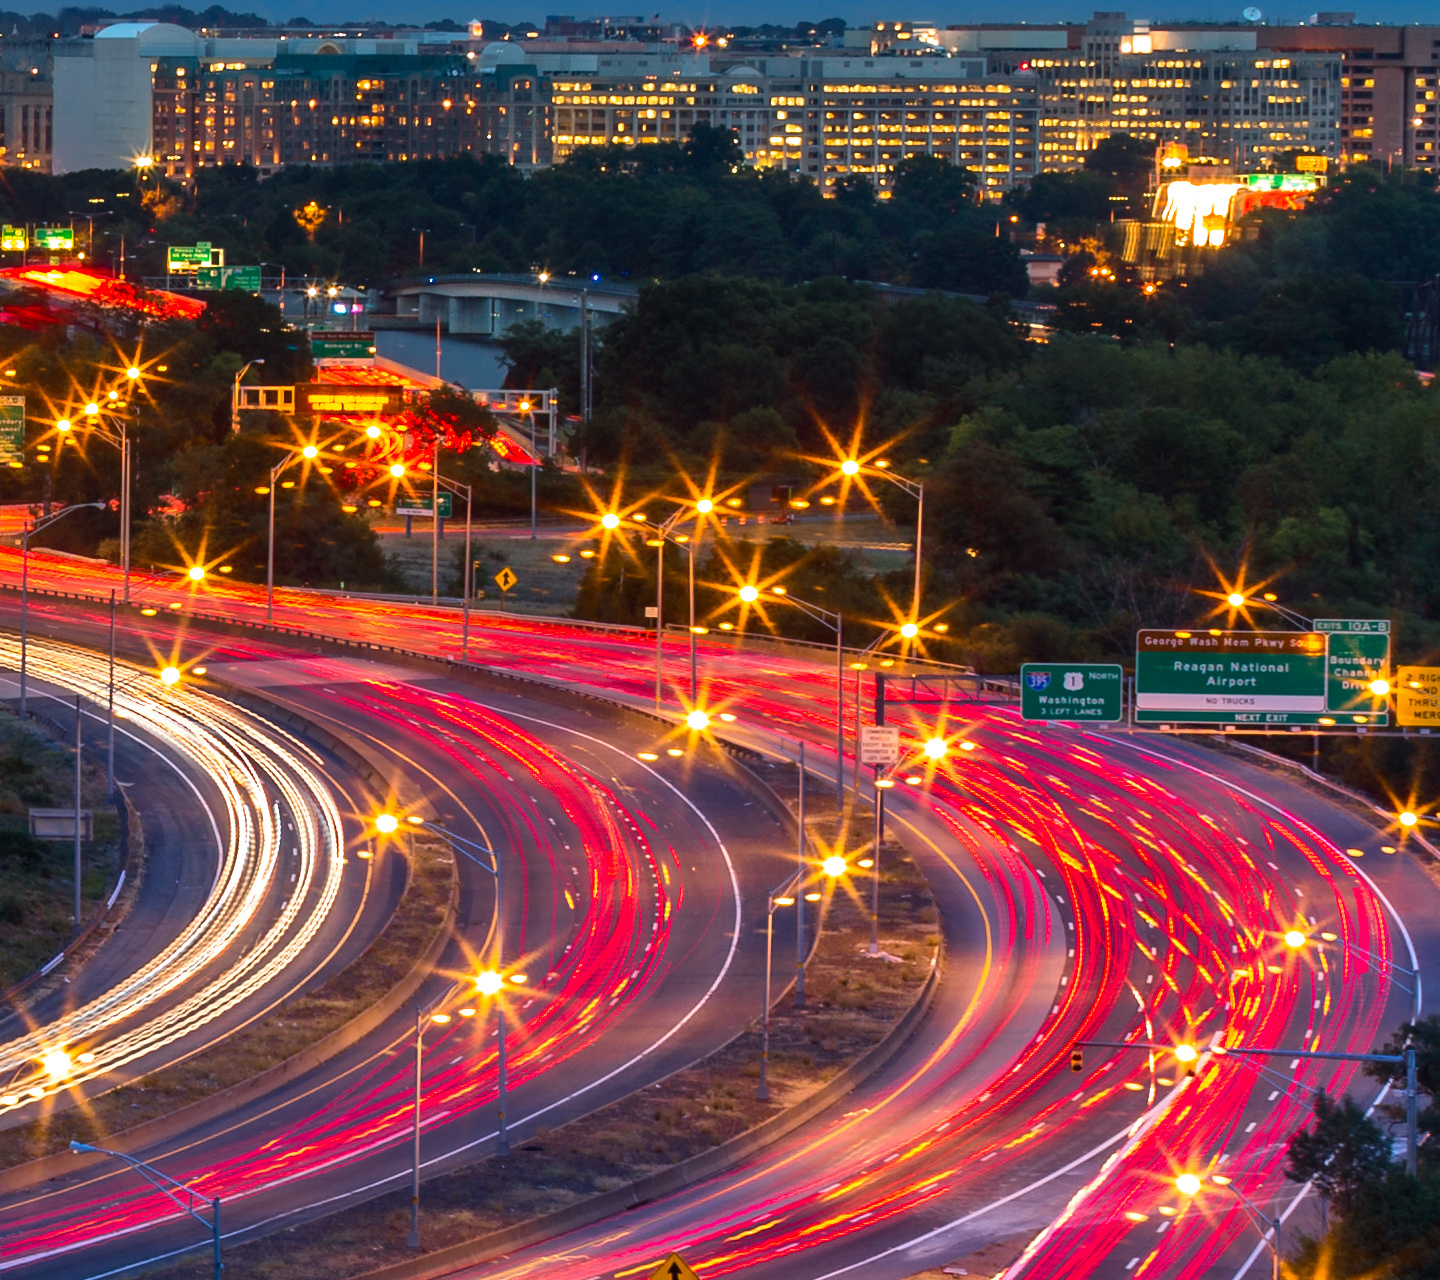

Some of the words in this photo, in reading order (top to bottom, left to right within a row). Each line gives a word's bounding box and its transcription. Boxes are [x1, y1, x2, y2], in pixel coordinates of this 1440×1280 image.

[1189, 637, 1218, 646] Wash
[1223, 638, 1250, 647] Mem
[1254, 638, 1285, 649] Pkwy
[1329, 655, 1385, 667] Boundary
[1173, 661, 1224, 675] Reagan
[1230, 662, 1290, 673] National
[1088, 672, 1119, 680] NORTH
[1206, 676, 1257, 688] Airport
[1038, 695, 1105, 707] Washington
[1074, 708, 1103, 716] LANES
[1235, 713, 1261, 721] NEXT
